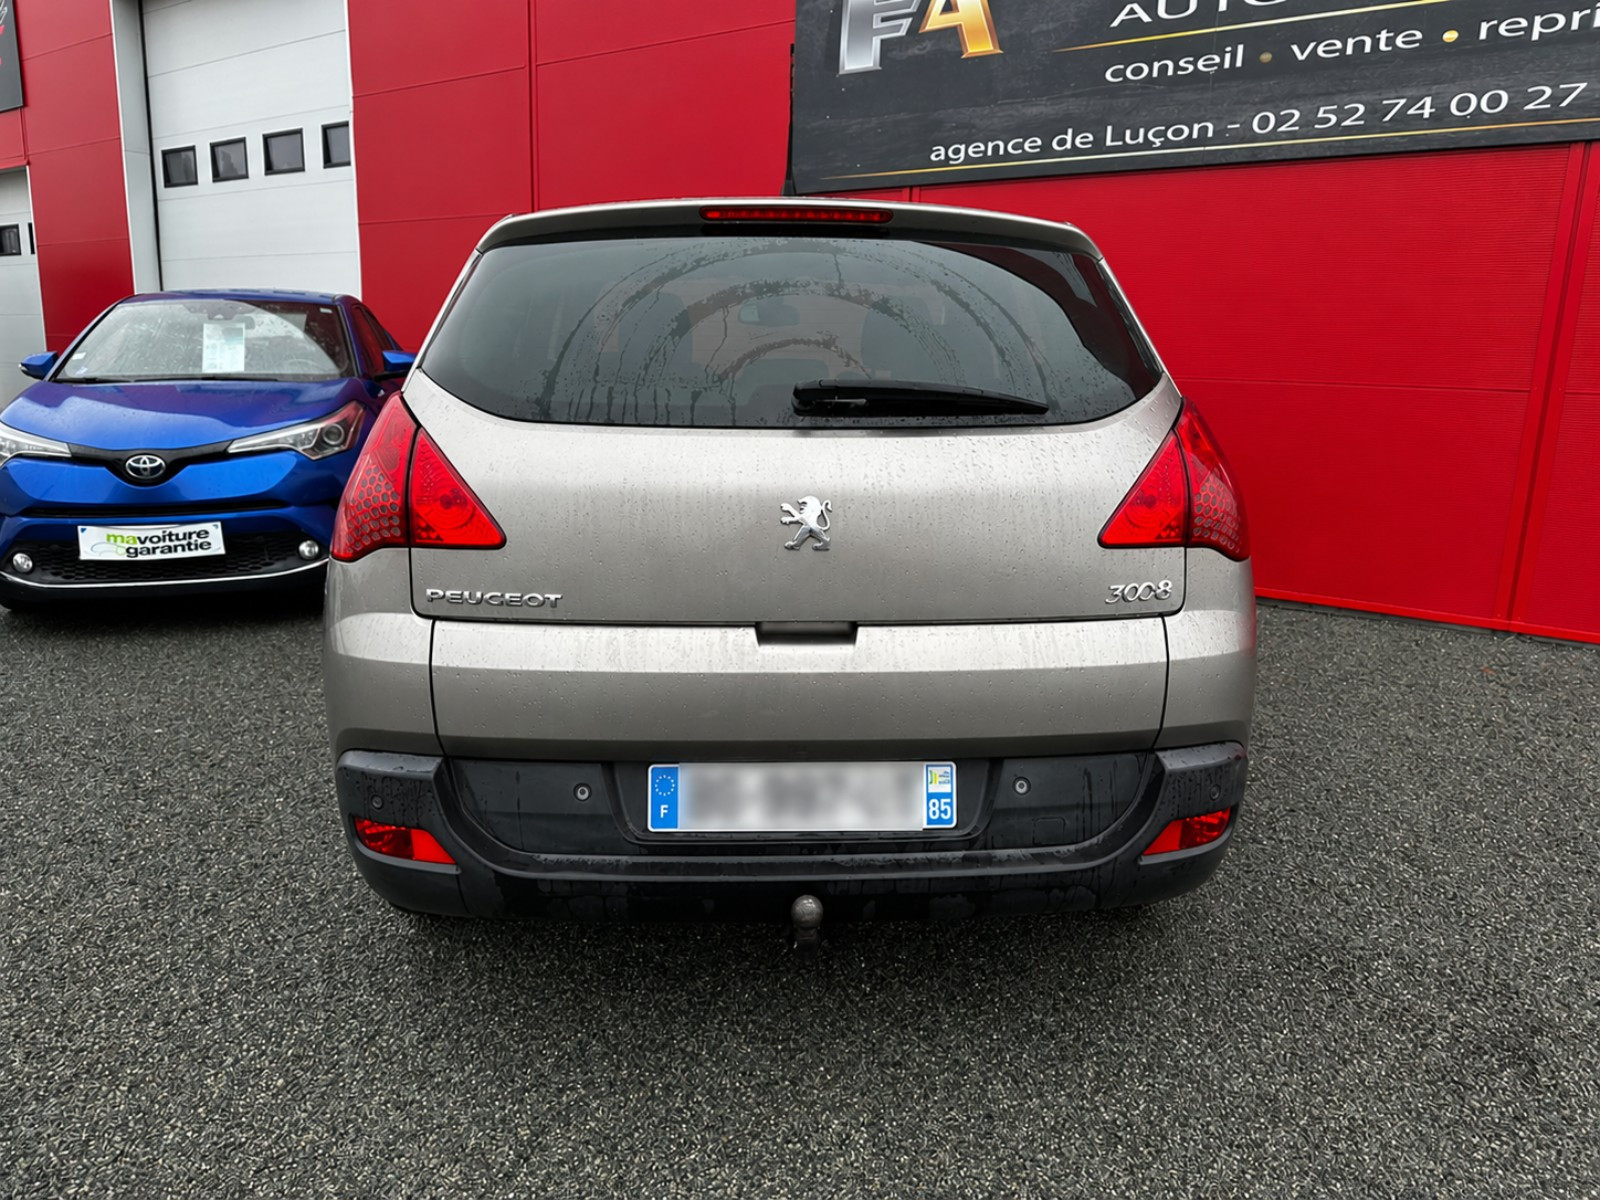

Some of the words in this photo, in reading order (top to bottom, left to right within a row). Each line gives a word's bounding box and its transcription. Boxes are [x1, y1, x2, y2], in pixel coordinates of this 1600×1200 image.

[1110, 0, 1287, 28] AU
[1104, 44, 1244, 82] conseil
[1290, 29, 1423, 61] vente
[1478, 2, 1600, 41] repri
[930, 136, 1042, 164] agence
[1051, 127, 1094, 150] de
[1105, 121, 1214, 147] Luçon
[1252, 109, 1301, 134] 02
[1314, 103, 1366, 129] 52
[1382, 96, 1436, 122] 74
[1449, 89, 1509, 116] 00
[1523, 82, 1588, 110] 27
[125, 539, 212, 558] garantie
[426, 588, 563, 608] PEUGEOT
[1105, 579, 1172, 604] 3008
[660, 804, 669, 818] F
[928, 798, 952, 820] 85
